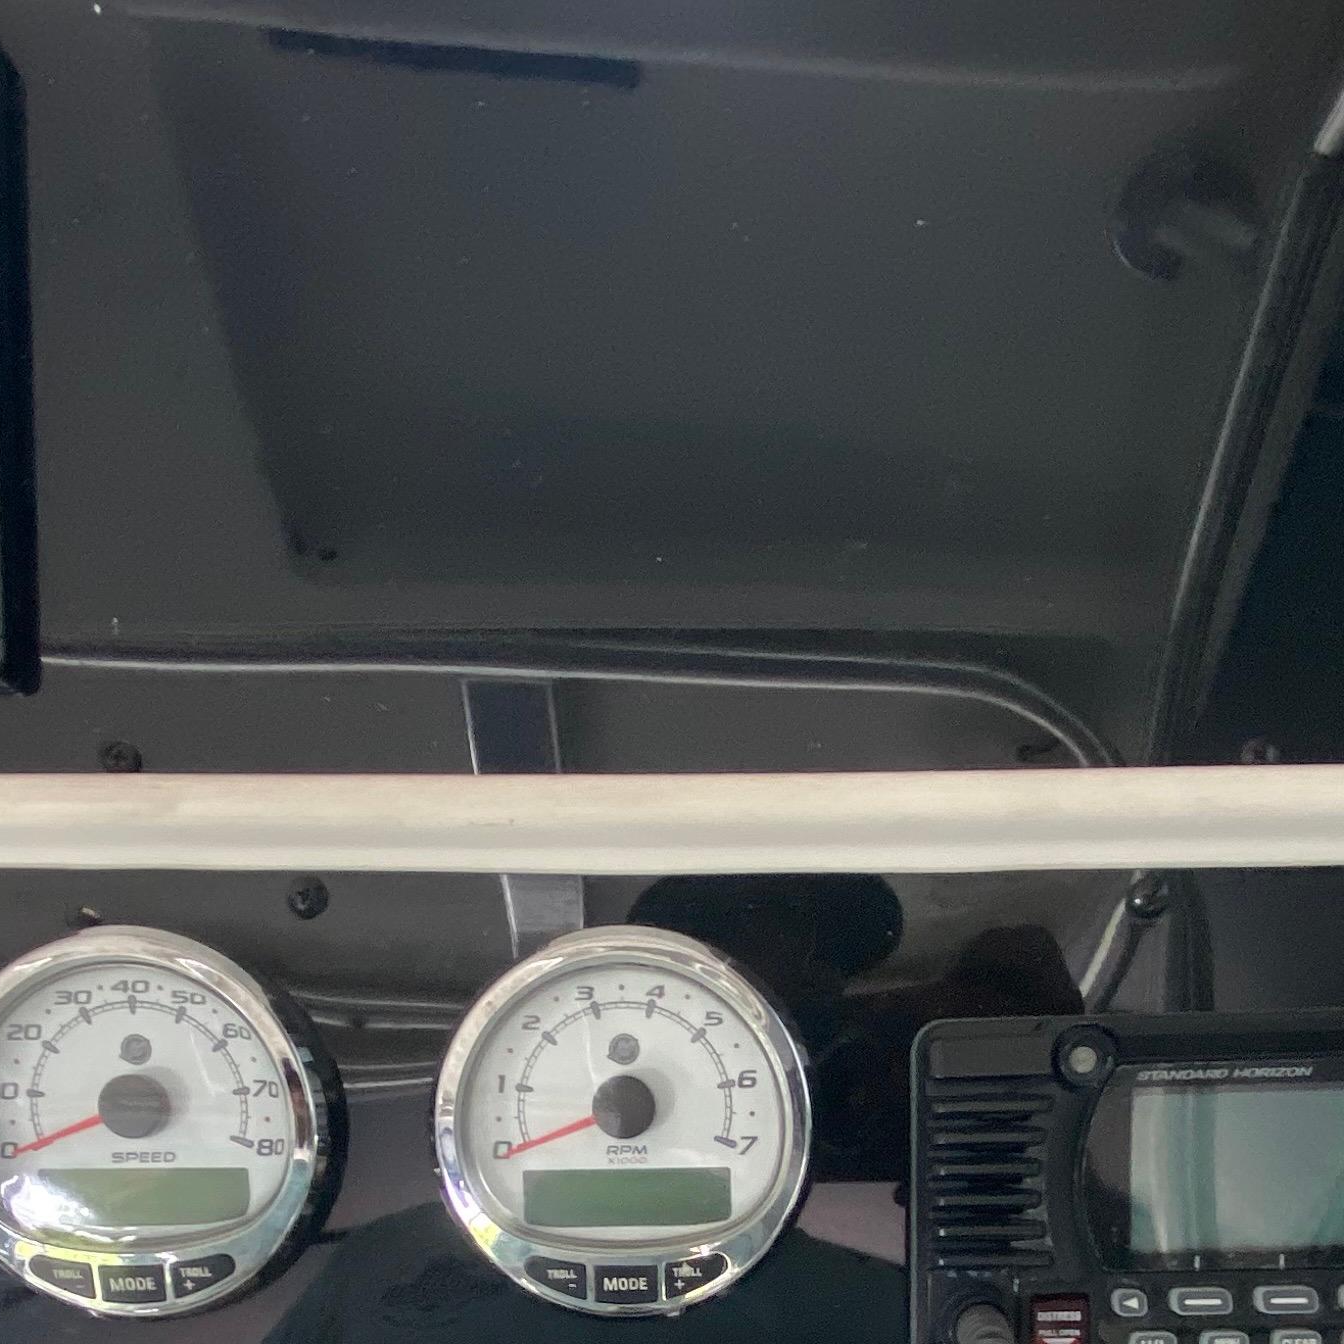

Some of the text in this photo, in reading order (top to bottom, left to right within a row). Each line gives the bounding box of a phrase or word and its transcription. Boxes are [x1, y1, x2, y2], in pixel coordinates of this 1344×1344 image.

[111, 980, 150, 994] 40
[574, 986, 595, 1000] 3
[645, 986, 666, 998] 4
[54, 990, 92, 1005] 30
[171, 991, 206, 1005] 50
[521, 1015, 542, 1030] 2
[704, 1011, 724, 1026] 5
[6, 1024, 41, 1040] 20
[222, 1024, 252, 1040] 60
[738, 1070, 757, 1088] 6
[1136, 1066, 1313, 1081] STANDARD HORIZON
[252, 1080, 279, 1098] 70
[496, 1074, 506, 1093] 1
[0, 1142, 18, 1159] 0
[256, 1138, 284, 1156] 80
[493, 1141, 512, 1160] 0
[606, 1145, 648, 1155] RPM
[736, 1136, 758, 1155] 7
[111, 1151, 176, 1164] SPEED
[180, 1267, 212, 1278] TROLL
[547, 1269, 577, 1279] TROLL
[109, 1277, 157, 1292] MODE
[603, 1277, 649, 1291] MODE
